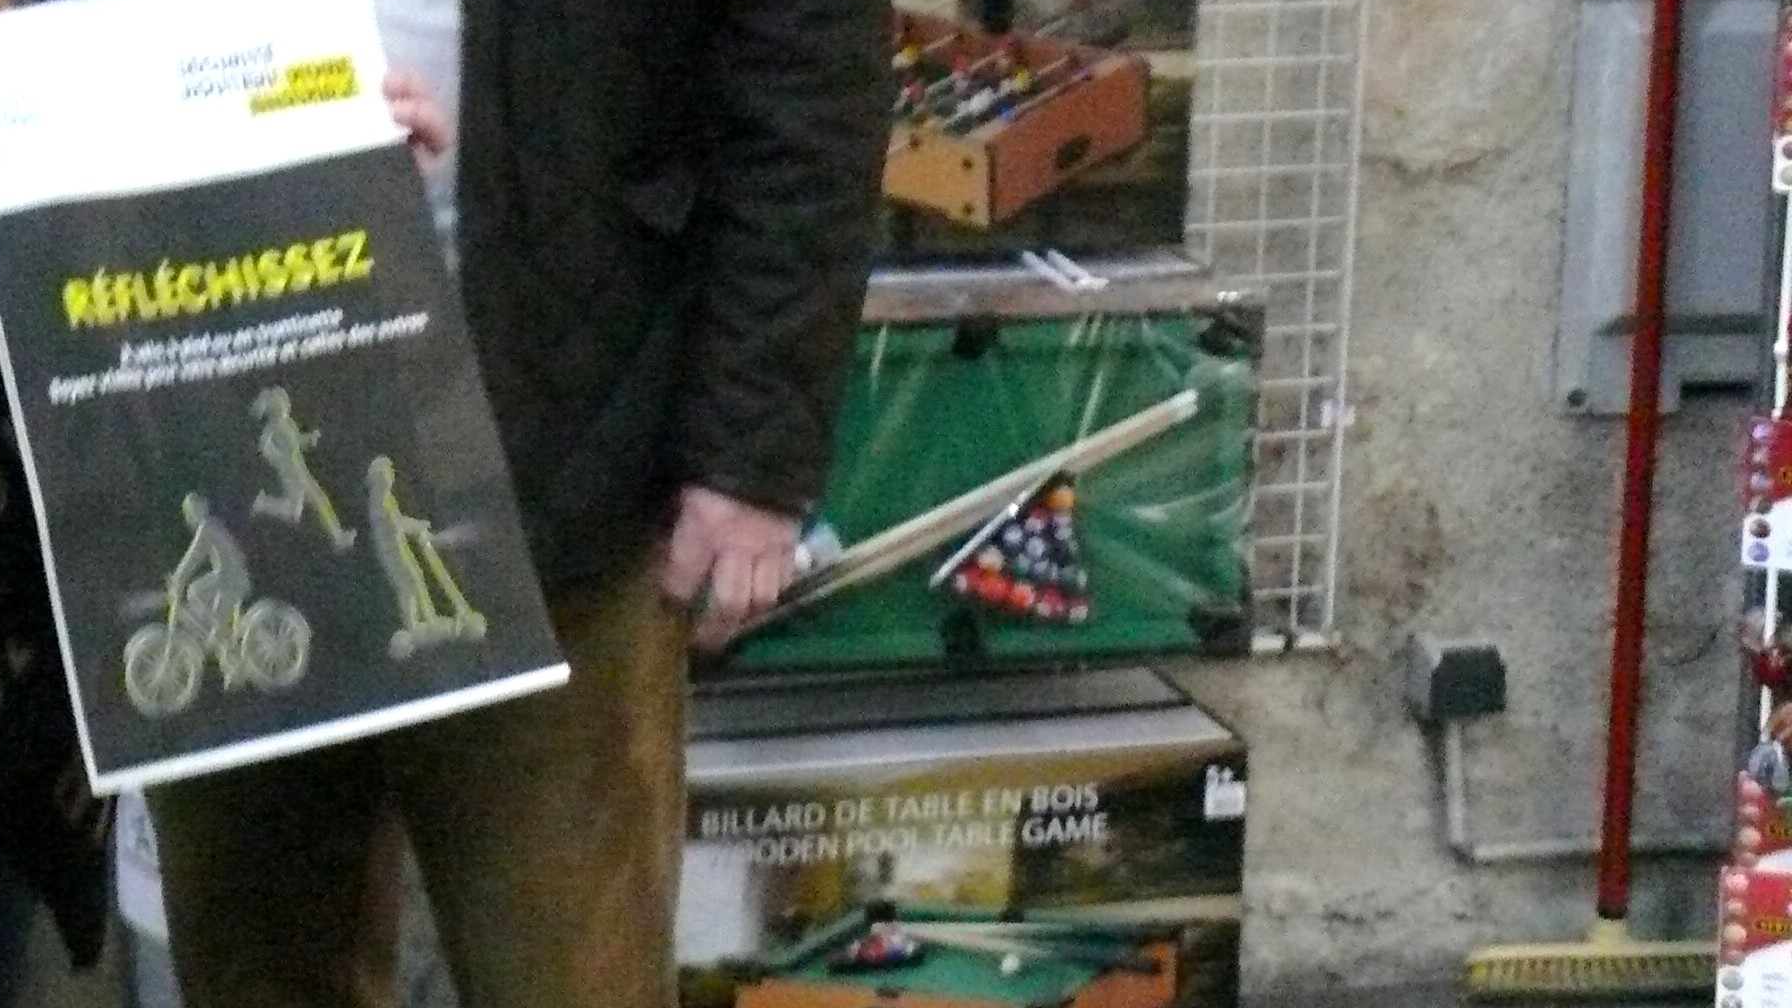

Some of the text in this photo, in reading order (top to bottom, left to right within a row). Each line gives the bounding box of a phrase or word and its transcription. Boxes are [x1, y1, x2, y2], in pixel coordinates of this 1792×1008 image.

[63, 229, 376, 330] RÉFLÉCHISSEZ
[700, 783, 1100, 838] BILLARD DE TABLE EN BOIS
[845, 827, 918, 858] POOL
[934, 821, 1015, 850] TABLE
[1021, 811, 1110, 847] GAME
